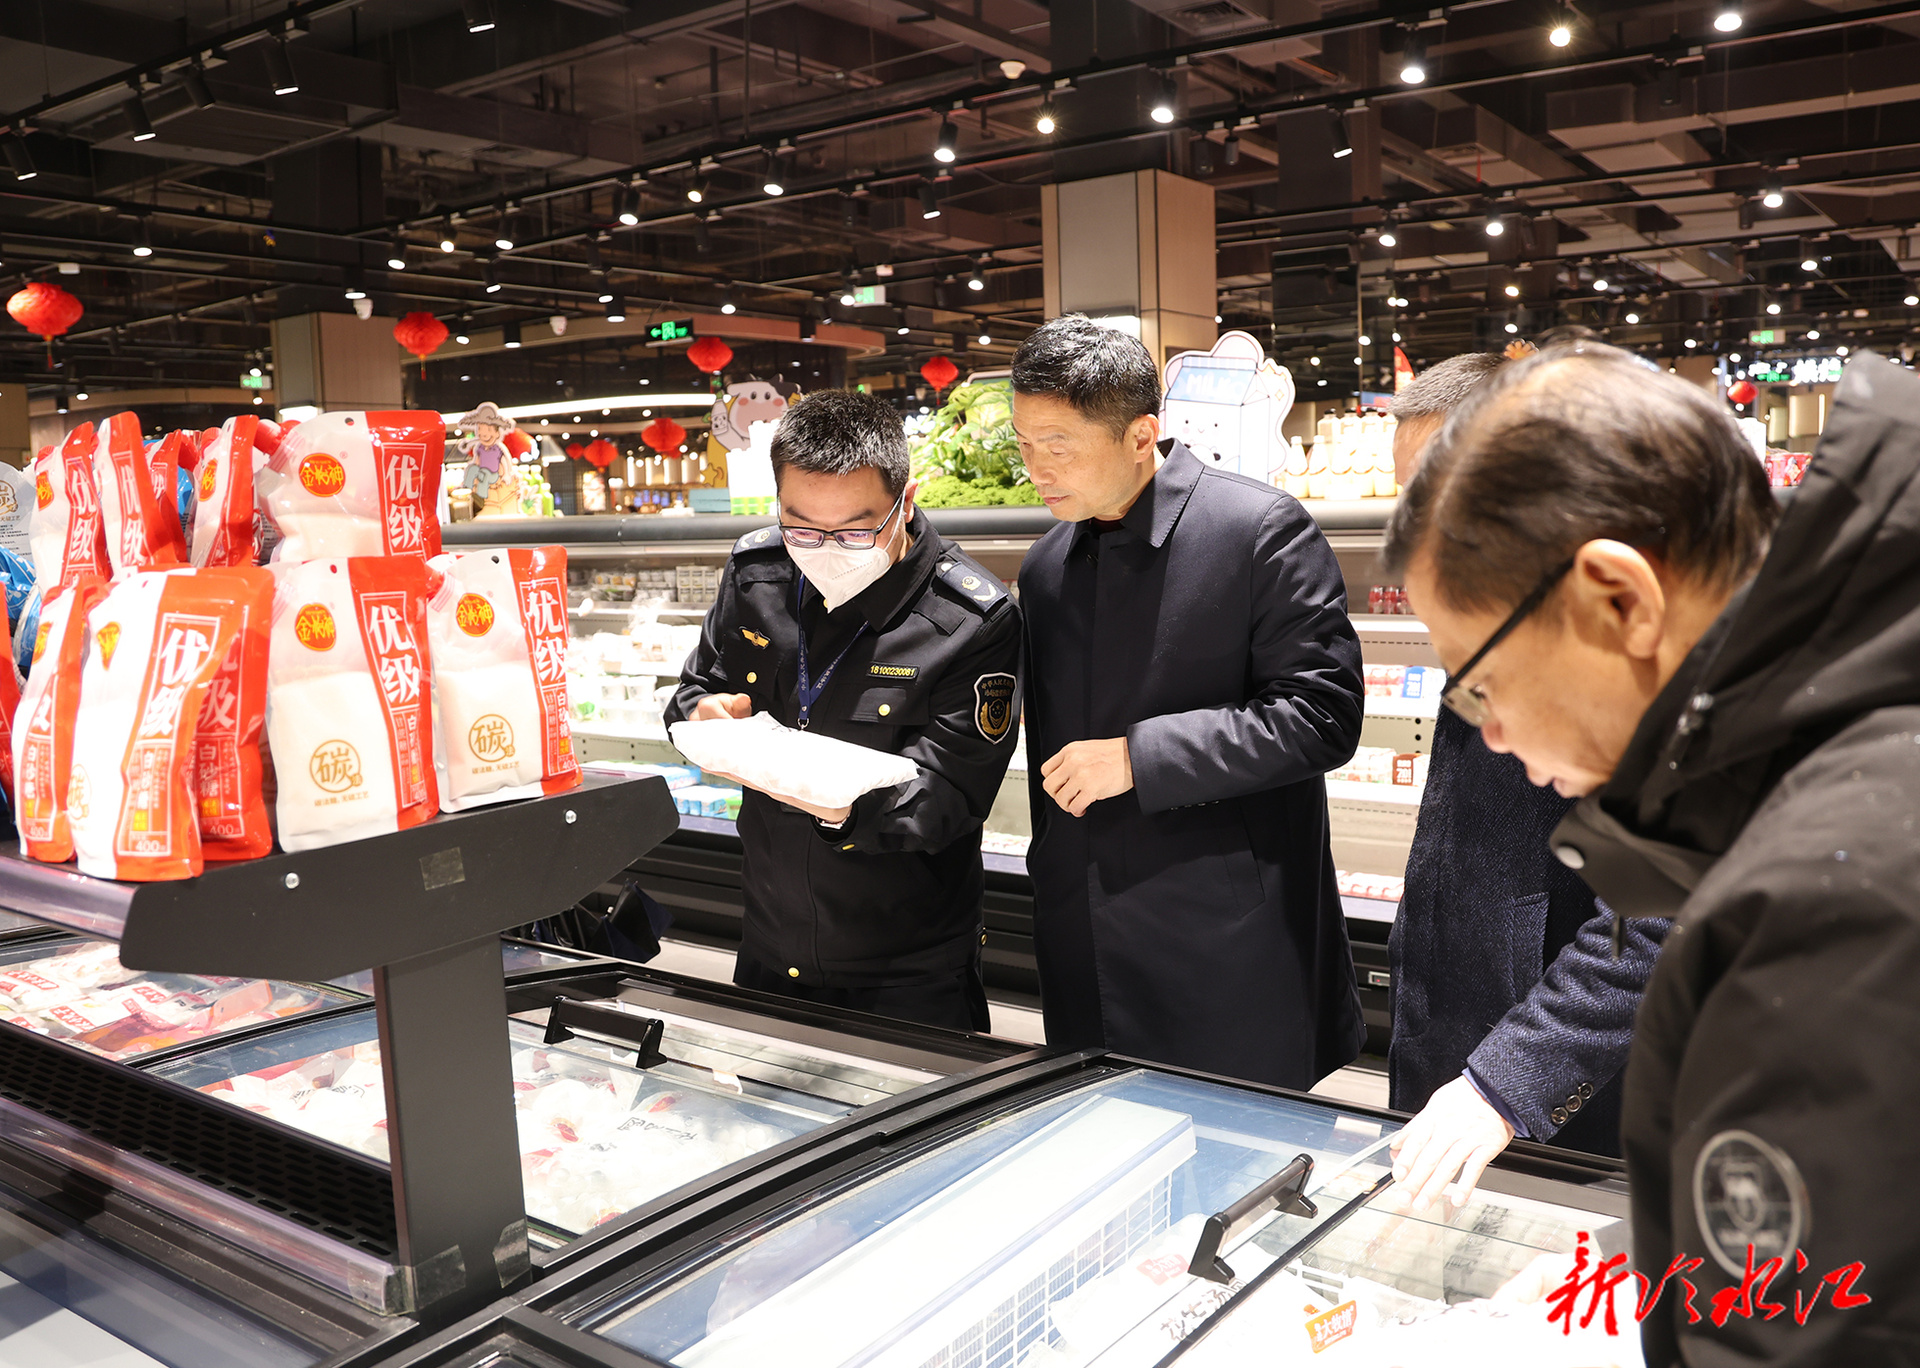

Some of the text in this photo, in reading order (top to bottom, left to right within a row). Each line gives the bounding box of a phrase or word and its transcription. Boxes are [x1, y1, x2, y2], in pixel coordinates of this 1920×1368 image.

[70, 469, 97, 561] 优级
[121, 465, 148, 566] 优级
[385, 454, 422, 548] 优级
[140, 627, 209, 737] 优级
[369, 604, 421, 703] 优级
[529, 590, 569, 682] 优级
[199, 744, 219, 797] 白砂糖
[313, 746, 353, 785] 碳
[472, 720, 507, 755] 碳
[135, 840, 160, 853] 400
